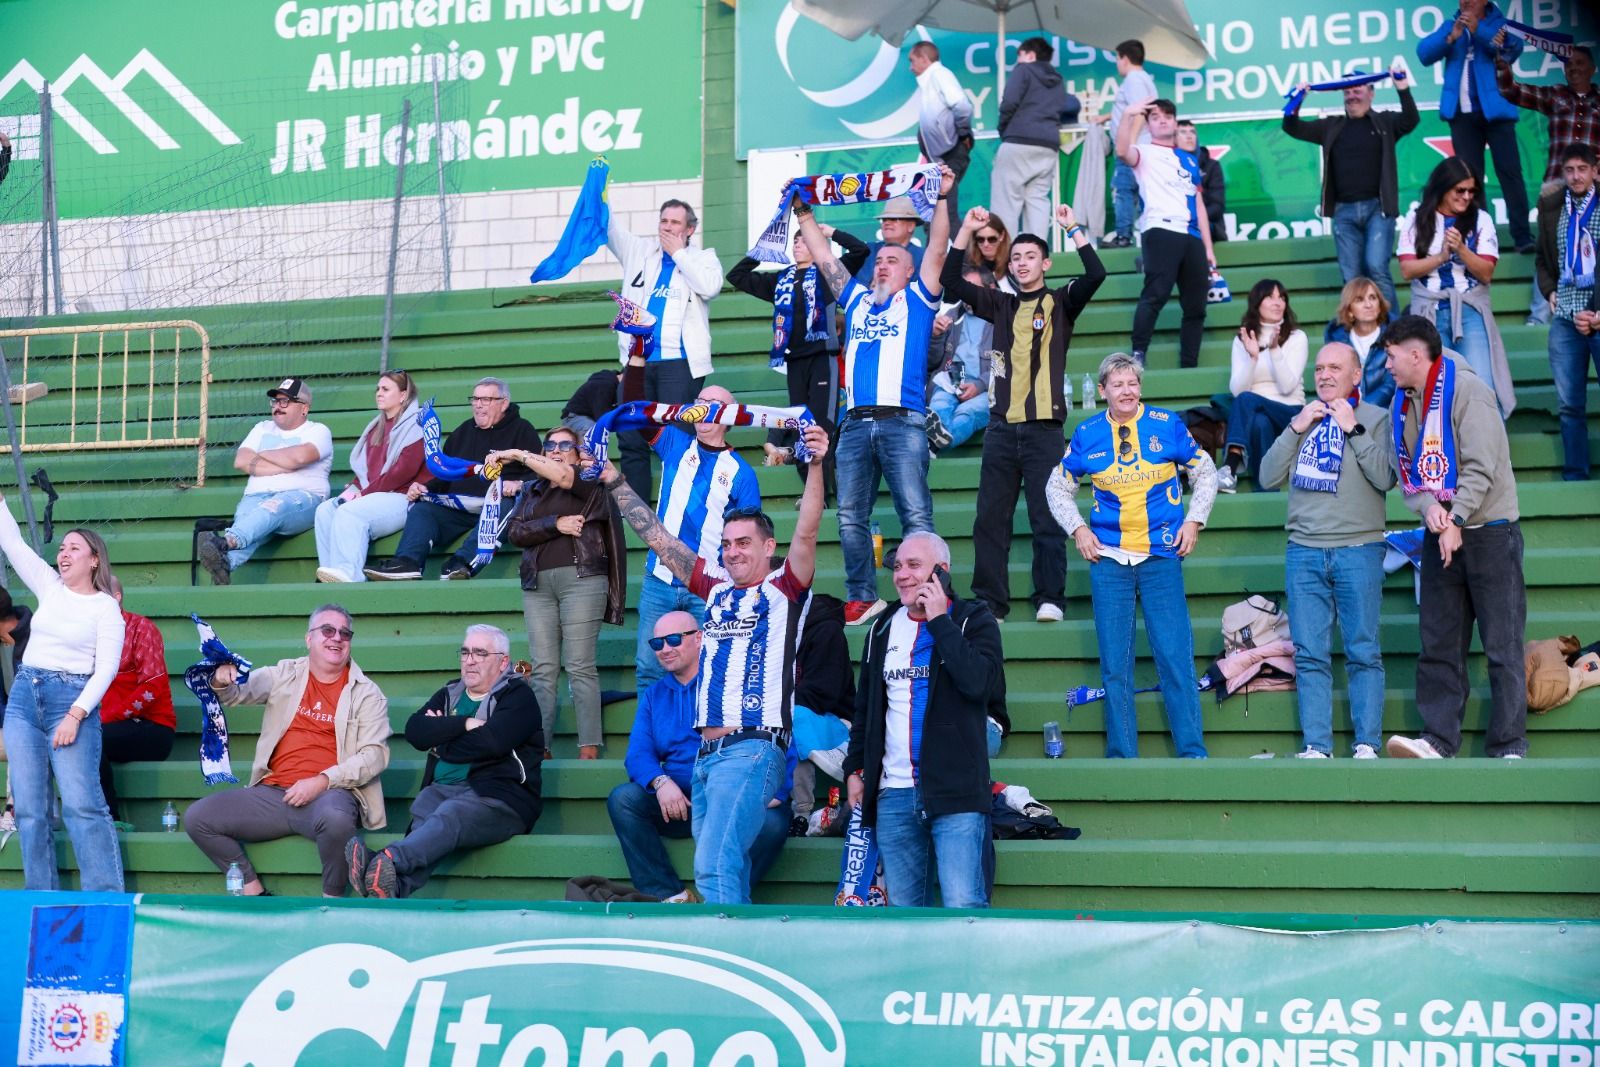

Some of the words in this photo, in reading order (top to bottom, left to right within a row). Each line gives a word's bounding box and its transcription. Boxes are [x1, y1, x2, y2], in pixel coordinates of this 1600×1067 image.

[1280, 5, 1445, 50] MEDIO
[307, 40, 486, 92] Aluminio
[496, 46, 519, 86] y
[531, 30, 605, 75] PVC
[270, 118, 327, 175] JR
[344, 97, 643, 169] Hernández
[748, 642, 762, 690] TRIOCAR
[296, 705, 336, 723] SCALPER
[843, 841, 869, 886] Real
[883, 987, 1244, 1032] CLIMATIZACIÓN
[1280, 998, 1382, 1035] GAS
[980, 1031, 1361, 1067] INSTALACIONES
